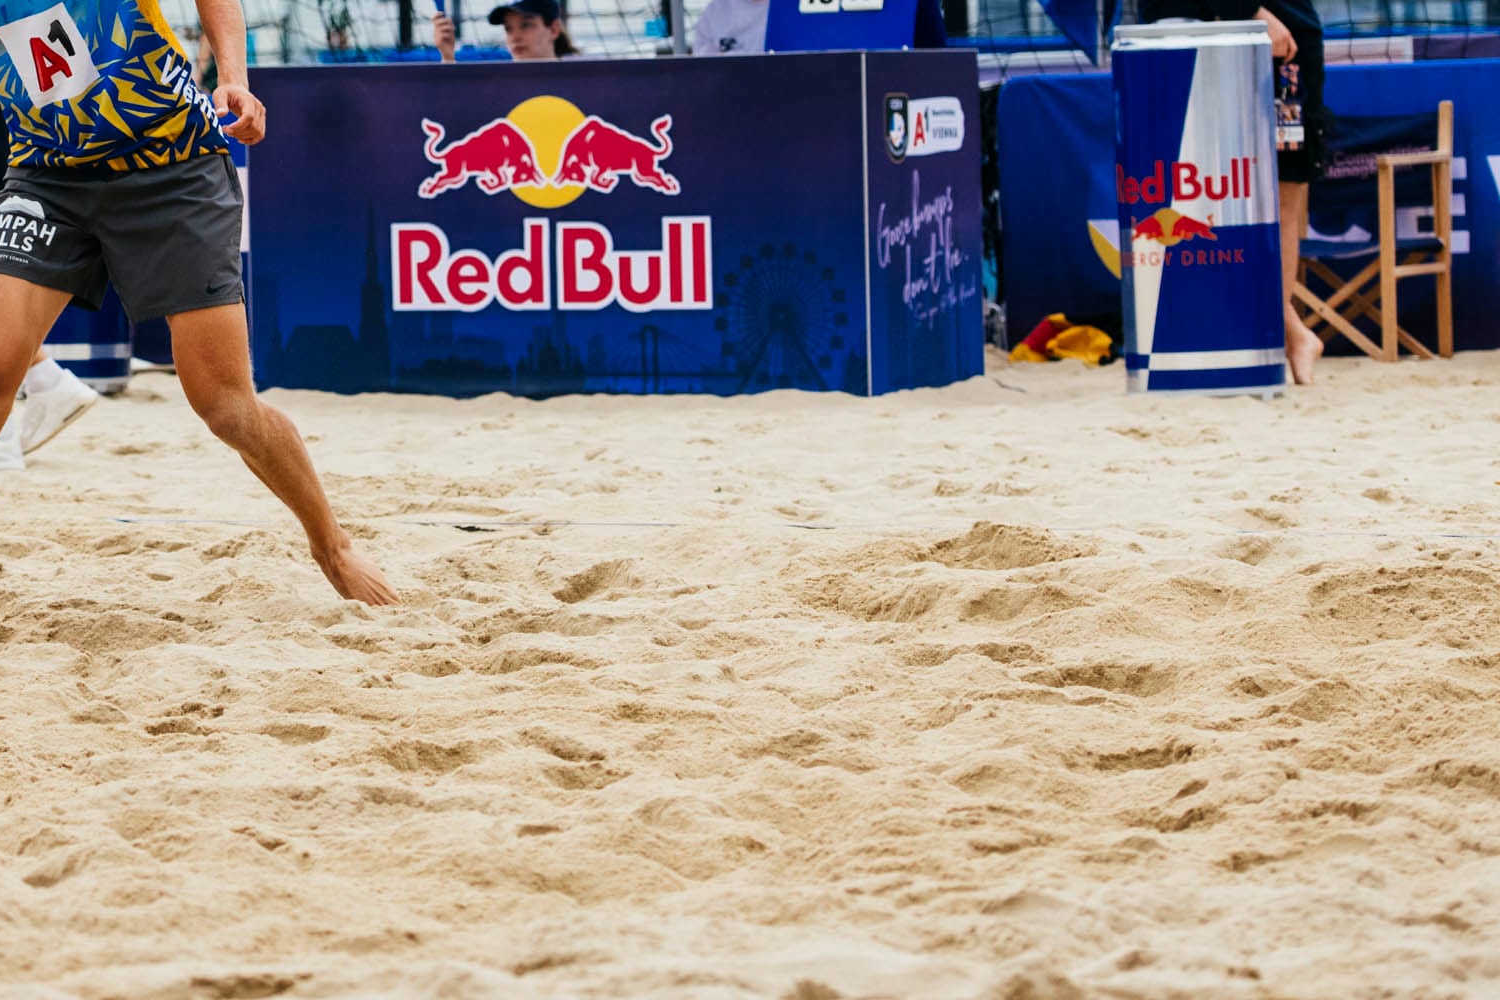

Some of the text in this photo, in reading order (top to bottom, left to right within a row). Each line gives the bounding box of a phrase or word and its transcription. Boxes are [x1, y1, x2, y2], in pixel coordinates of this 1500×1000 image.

[29, 20, 76, 92] A1
[161, 54, 229, 144] Vienn
[1171, 157, 1251, 201] Bull
[392, 217, 712, 310] Red Bull
[1181, 249, 1245, 266] DRINK
